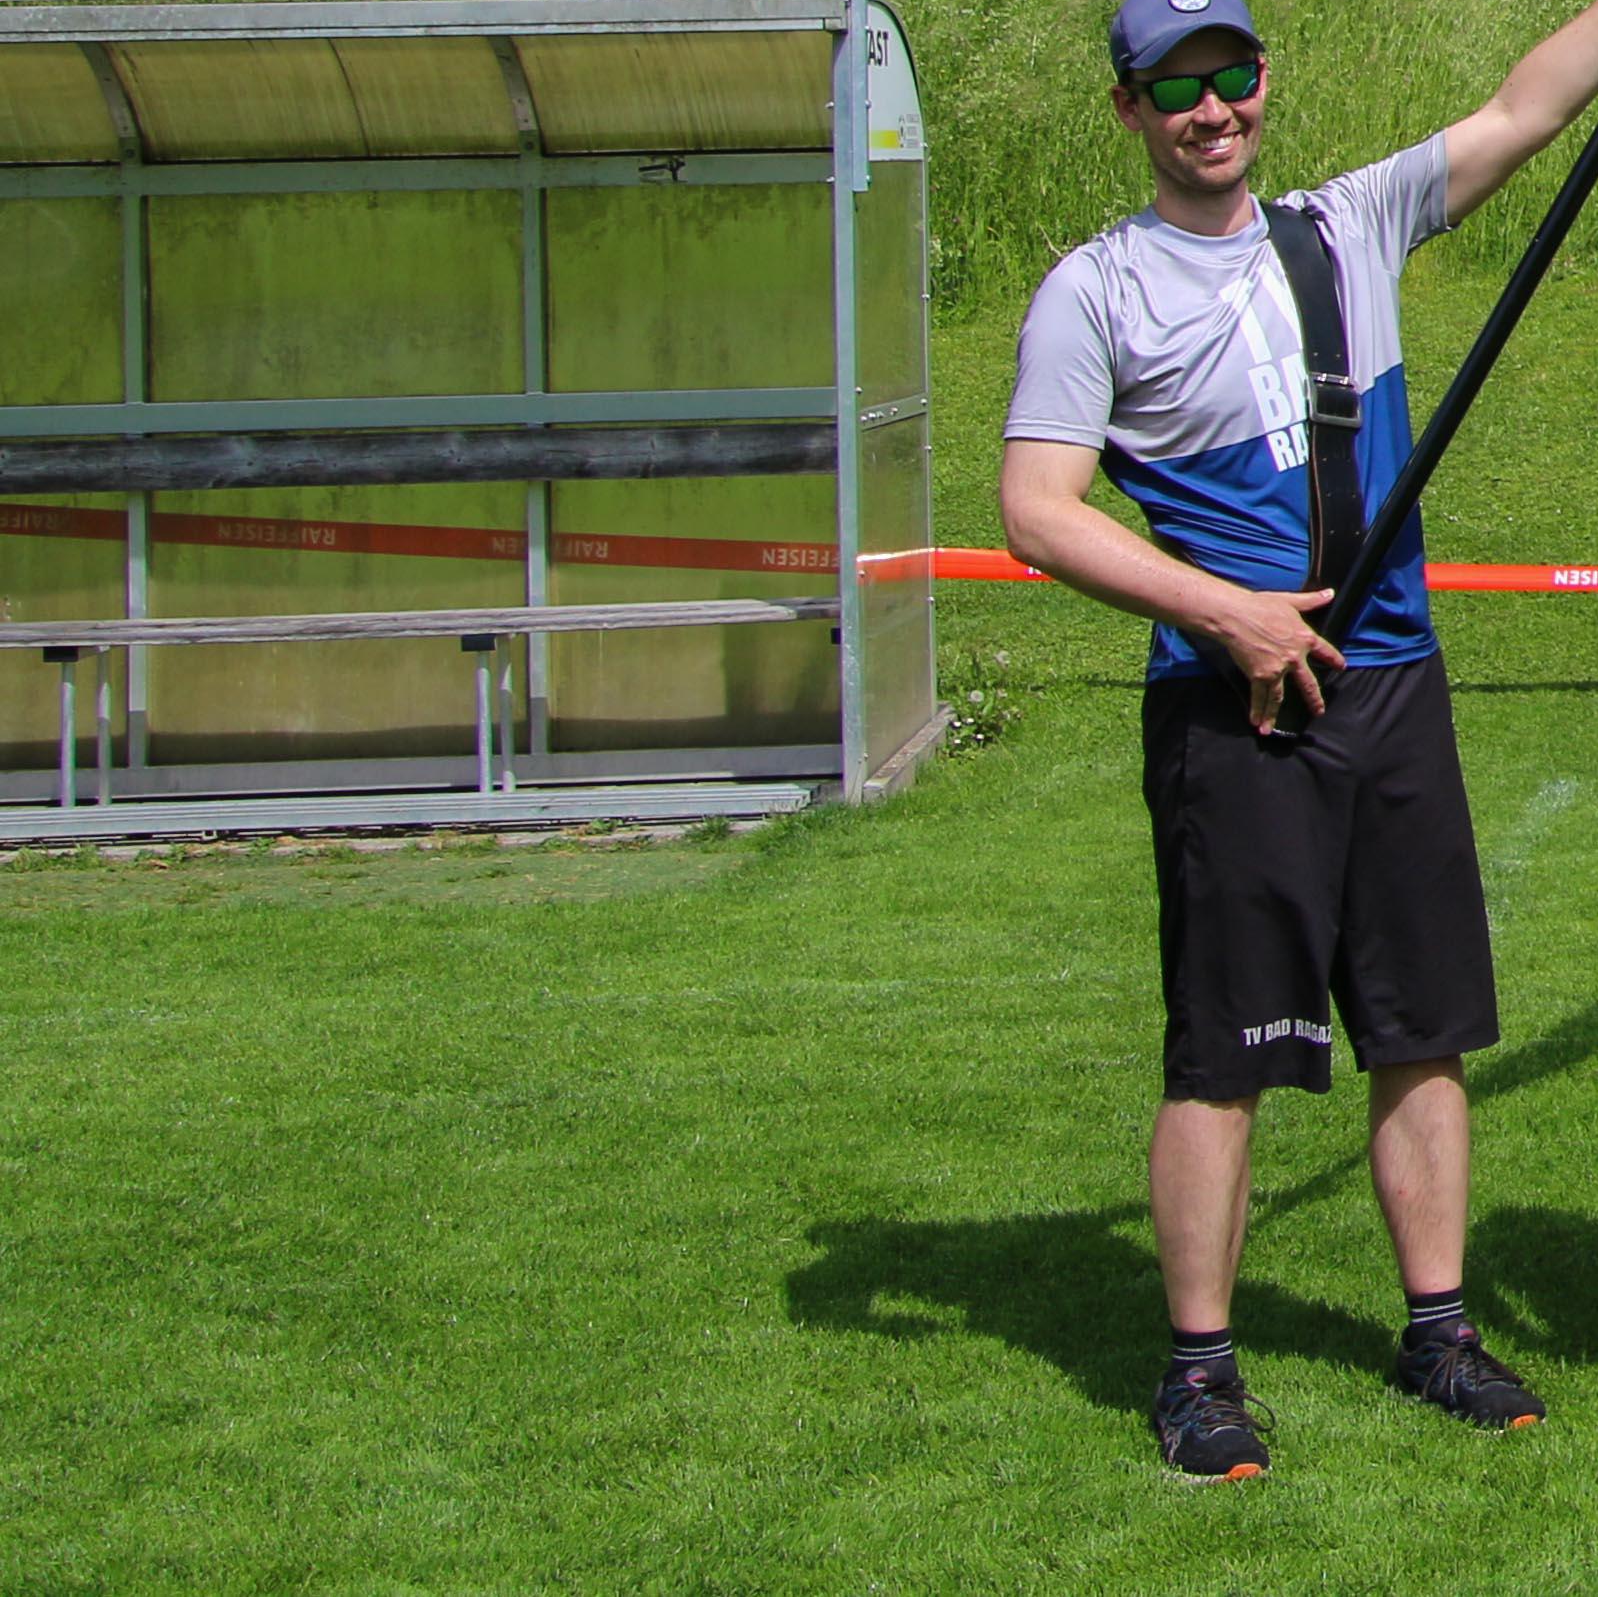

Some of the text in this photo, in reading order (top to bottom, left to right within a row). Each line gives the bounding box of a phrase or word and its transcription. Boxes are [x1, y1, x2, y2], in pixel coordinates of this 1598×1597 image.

[1243, 1018, 1332, 1046] TV BAD RAGAZ
